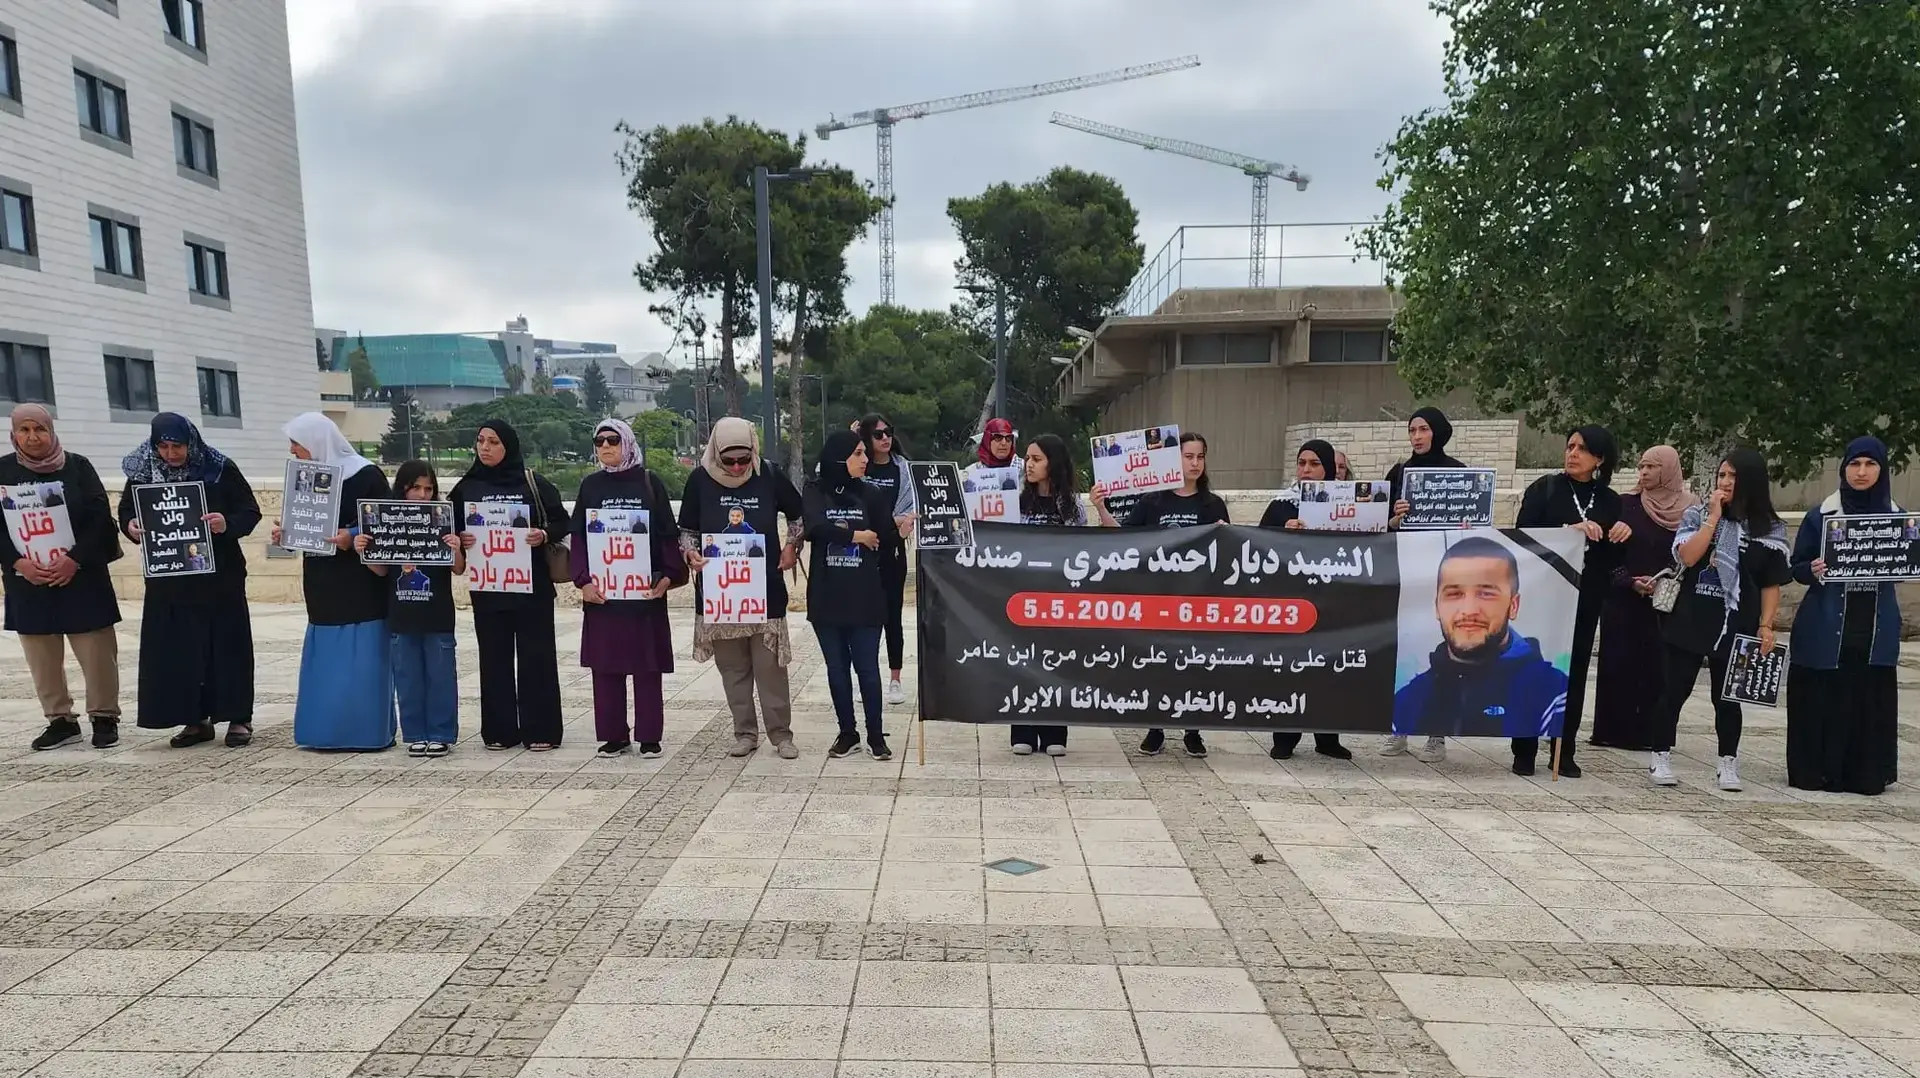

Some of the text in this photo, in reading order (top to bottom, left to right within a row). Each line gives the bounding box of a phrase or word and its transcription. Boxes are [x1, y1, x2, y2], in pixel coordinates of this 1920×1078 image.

[1124, 451, 1149, 472] قتل
[928, 465, 939, 477] لن
[1162, 468, 1181, 484] على
[922, 476, 949, 487] ننسى
[1132, 471, 1159, 491] خلفية
[162, 486, 177, 500] لن
[293, 493, 328, 505] قتل ديار
[930, 488, 948, 501] ولن
[152, 497, 190, 510] ننسى
[924, 504, 960, 518] نسامح!
[974, 494, 1004, 520] قتل
[1330, 503, 1356, 521] قتل
[161, 511, 185, 525] ولن
[291, 507, 329, 521] هو تنفيذ
[19, 511, 54, 542] قتل
[293, 521, 324, 533] لسياسة
[923, 522, 944, 530] الشهيد
[150, 527, 200, 546] نسامح!
[293, 537, 313, 547] غفير
[314, 540, 325, 549] بن
[482, 530, 515, 558] قتل
[921, 534, 948, 544] ديار عمري
[152, 548, 177, 558] الشهيد
[602, 536, 635, 565] قتل
[1147, 538, 1218, 574] احمد
[149, 561, 184, 572] ديار عمري
[1063, 547, 1140, 588] عمري
[1223, 539, 1280, 585] ديار
[1287, 545, 1374, 585] الشهيد
[470, 560, 531, 591] بدم بارد
[718, 560, 751, 589] قتل
[623, 574, 651, 599] بدم
[705, 593, 765, 622] بدم بارد
[1024, 599, 1142, 621] 5.5.2004
[1179, 602, 1299, 625] 6.5.2023
[956, 639, 1367, 673] قتل على يد مستوطن على ارض مرج ابن عامر
[998, 684, 1307, 720] المجد والخلود لشهدائنا الابرار
